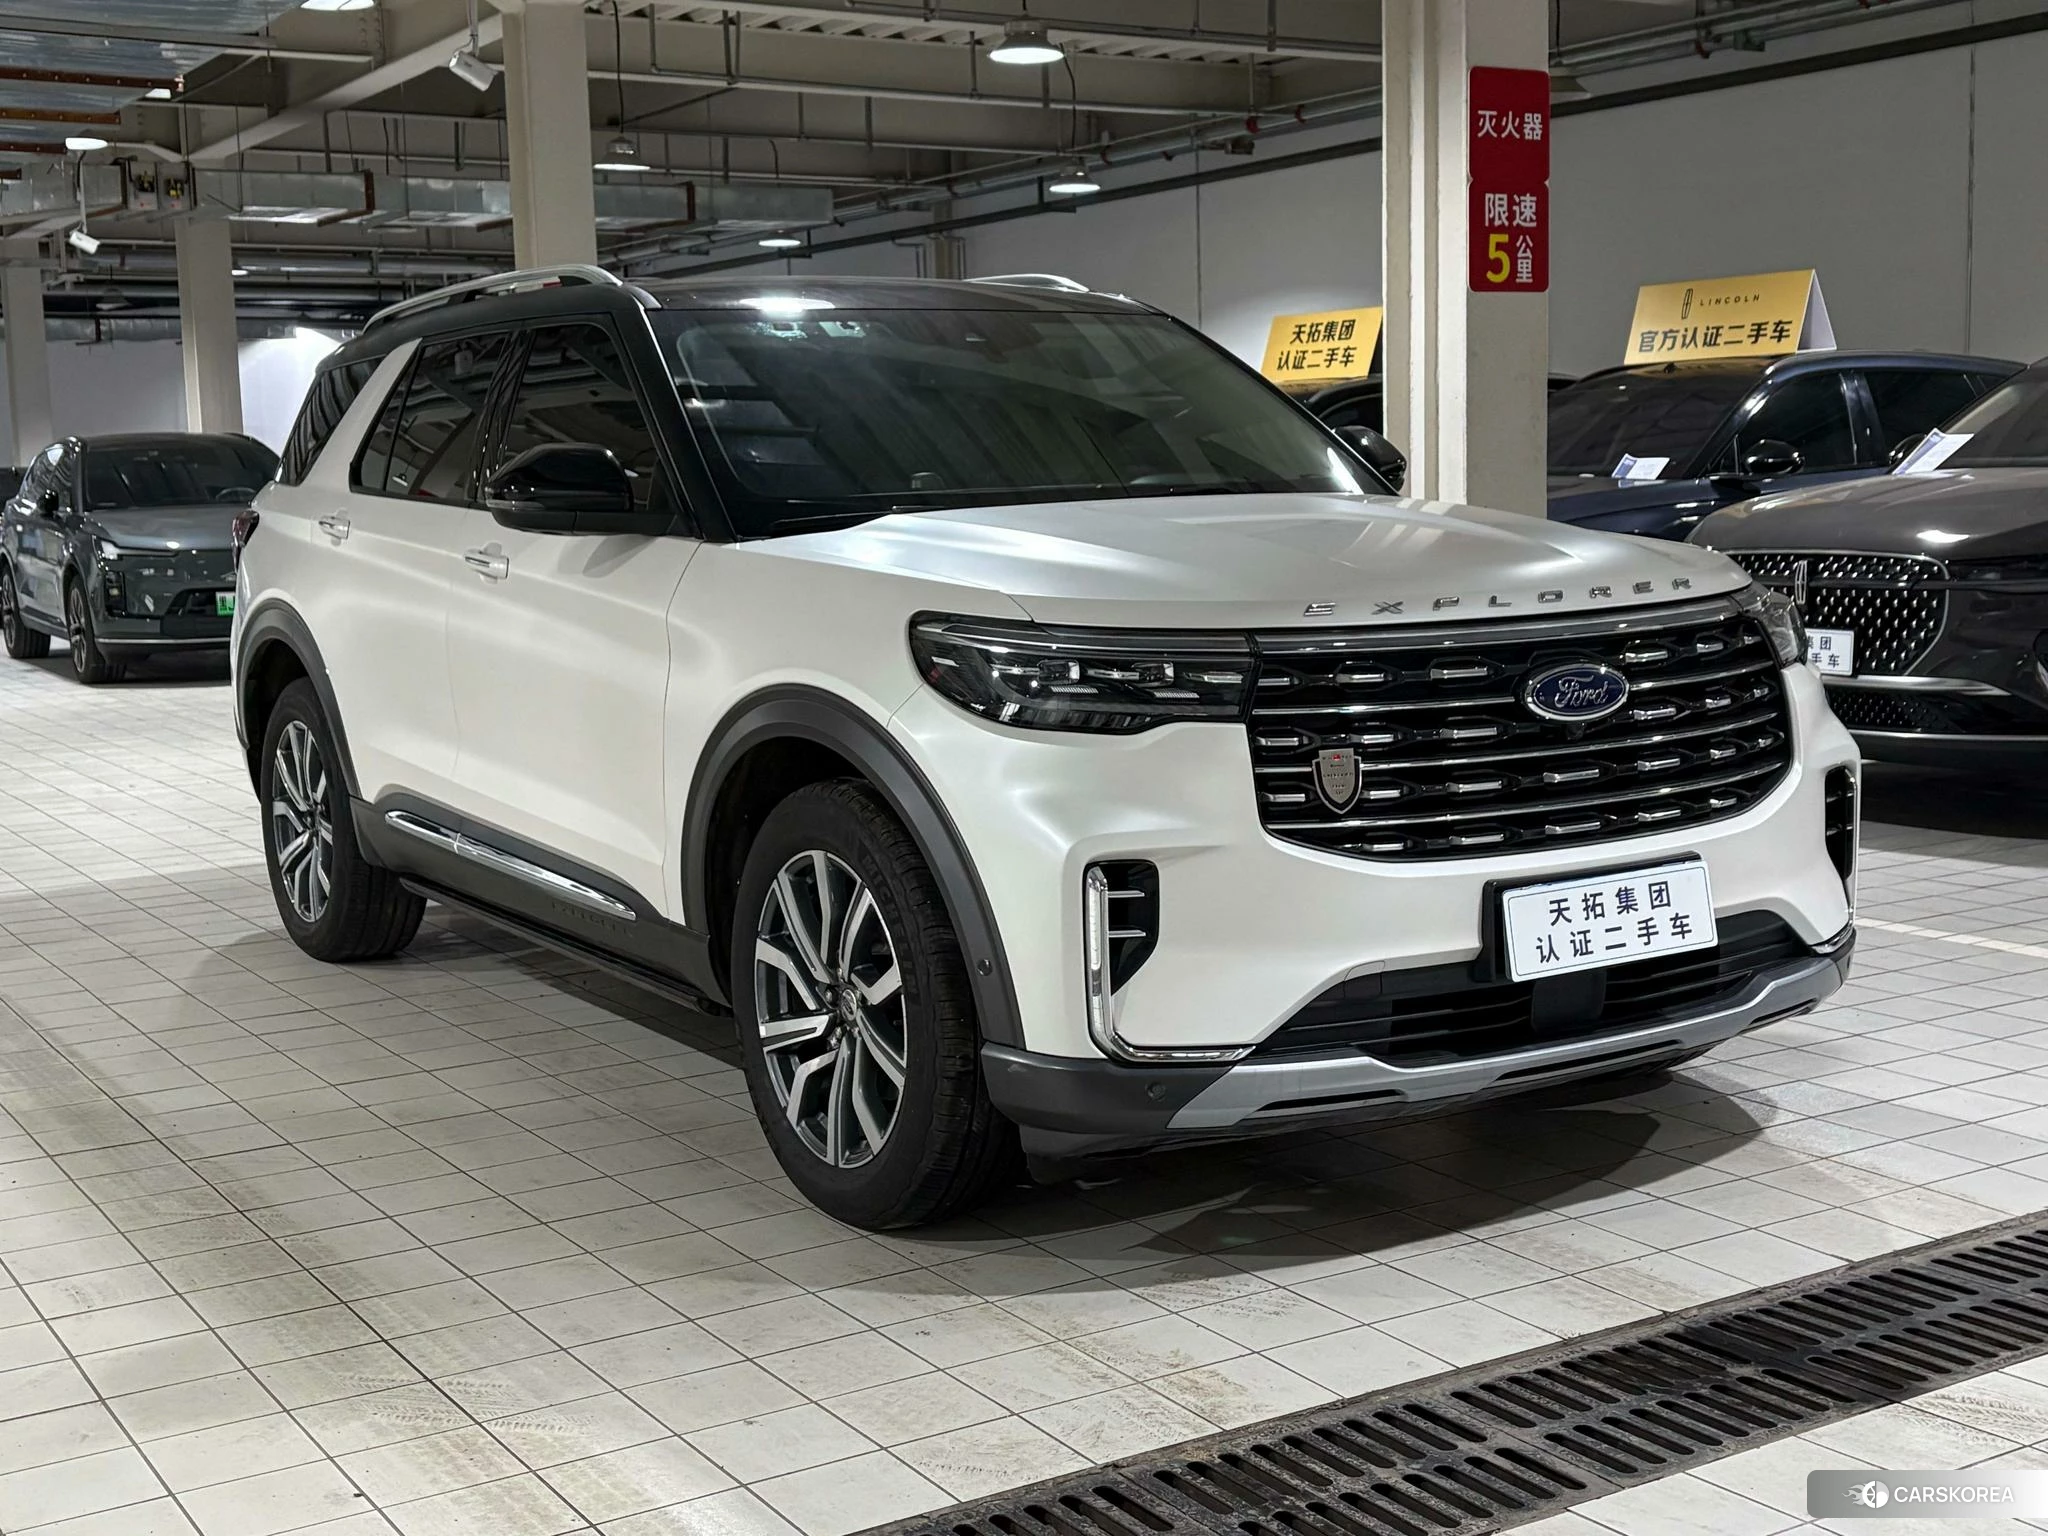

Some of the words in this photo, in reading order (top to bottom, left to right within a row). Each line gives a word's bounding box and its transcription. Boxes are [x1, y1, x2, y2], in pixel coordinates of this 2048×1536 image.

[1477, 110, 1543, 141] 灭火器
[1484, 193, 1537, 227] 限速
[1700, 294, 1760, 307] LINCOLN
[1289, 319, 1357, 345] 天拓集团
[1638, 319, 1793, 353] 官方认证二手车
[1276, 345, 1358, 371] 认证二手车
[1303, 576, 1693, 618] EXPLORER
[1554, 673, 1610, 709] Ford
[1549, 881, 1672, 927] 天拓集团
[1535, 912, 1693, 964] 认证二手车
